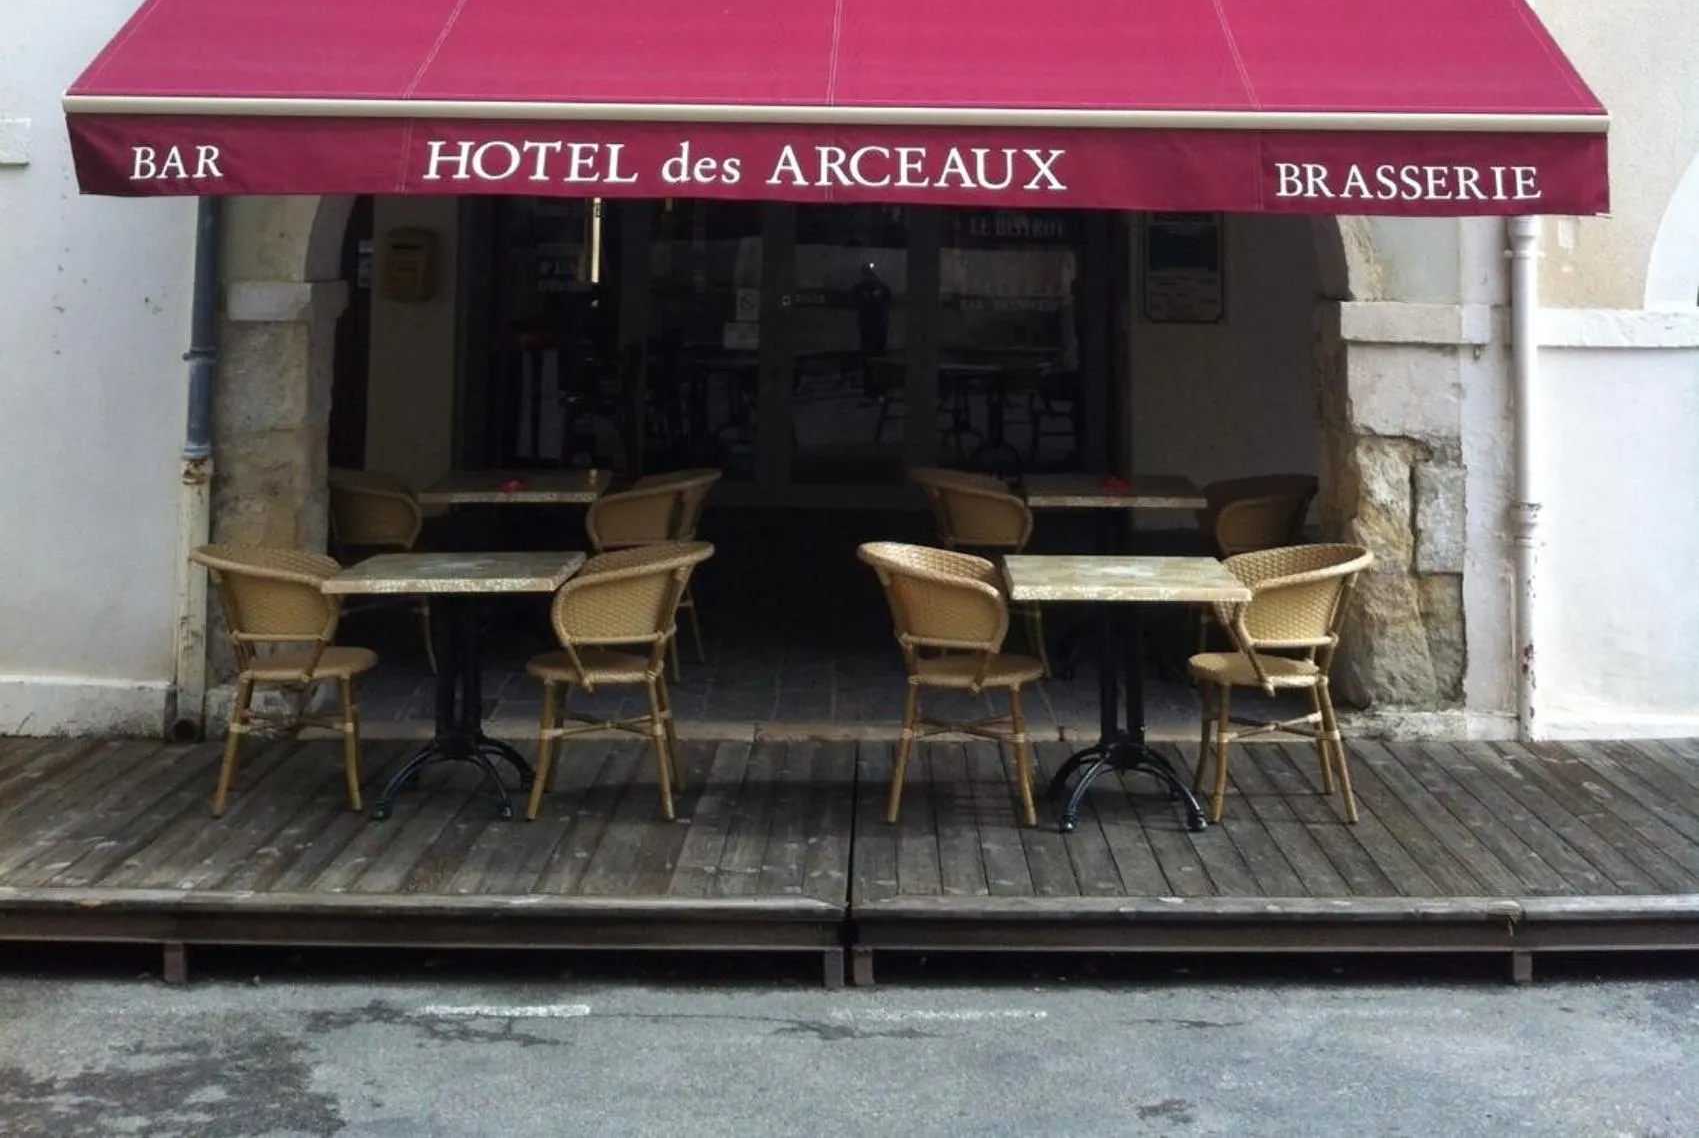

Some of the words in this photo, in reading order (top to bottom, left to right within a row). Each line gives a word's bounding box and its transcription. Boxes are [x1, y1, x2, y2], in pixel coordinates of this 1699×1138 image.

[130, 144, 224, 182] BAR
[423, 140, 639, 184] HOTEL
[661, 141, 742, 186] des
[766, 144, 1068, 191] ARCEAUX
[1274, 162, 1543, 201] BRASSERIE
